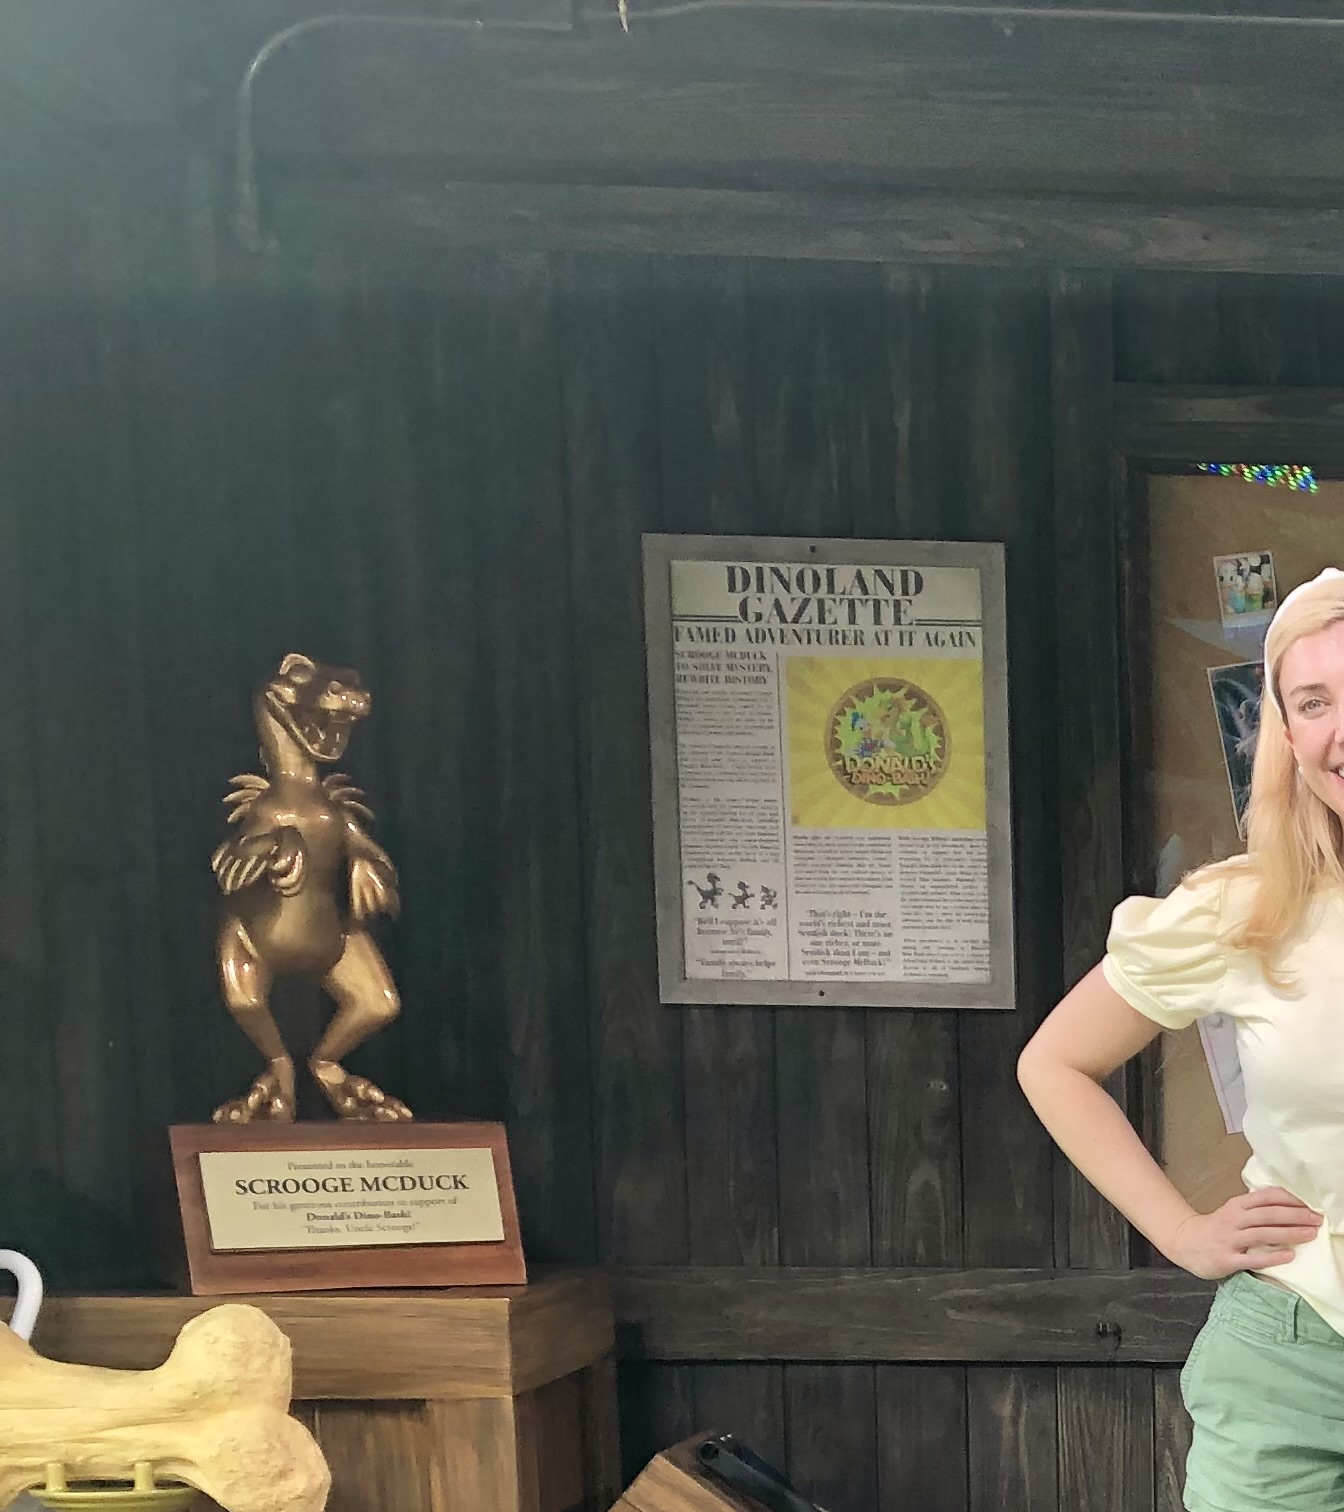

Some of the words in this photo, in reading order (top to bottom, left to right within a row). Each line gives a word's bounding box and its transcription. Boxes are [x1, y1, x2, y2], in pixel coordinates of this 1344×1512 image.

[724, 565, 923, 597] DINOLAND
[738, 596, 915, 626] GAZETTE
[674, 626, 736, 644] FAMED
[745, 628, 866, 647] ADVENTURER
[872, 630, 893, 647] AT
[899, 630, 917, 648] IT
[924, 630, 977, 648] AGAIN
[349, 1160, 363, 1170] the
[235, 1177, 354, 1195] SCROOGE
[360, 1174, 470, 1193] MCDUCK
[253, 1202, 270, 1210] For
[306, 1212, 351, 1222] Donald's
